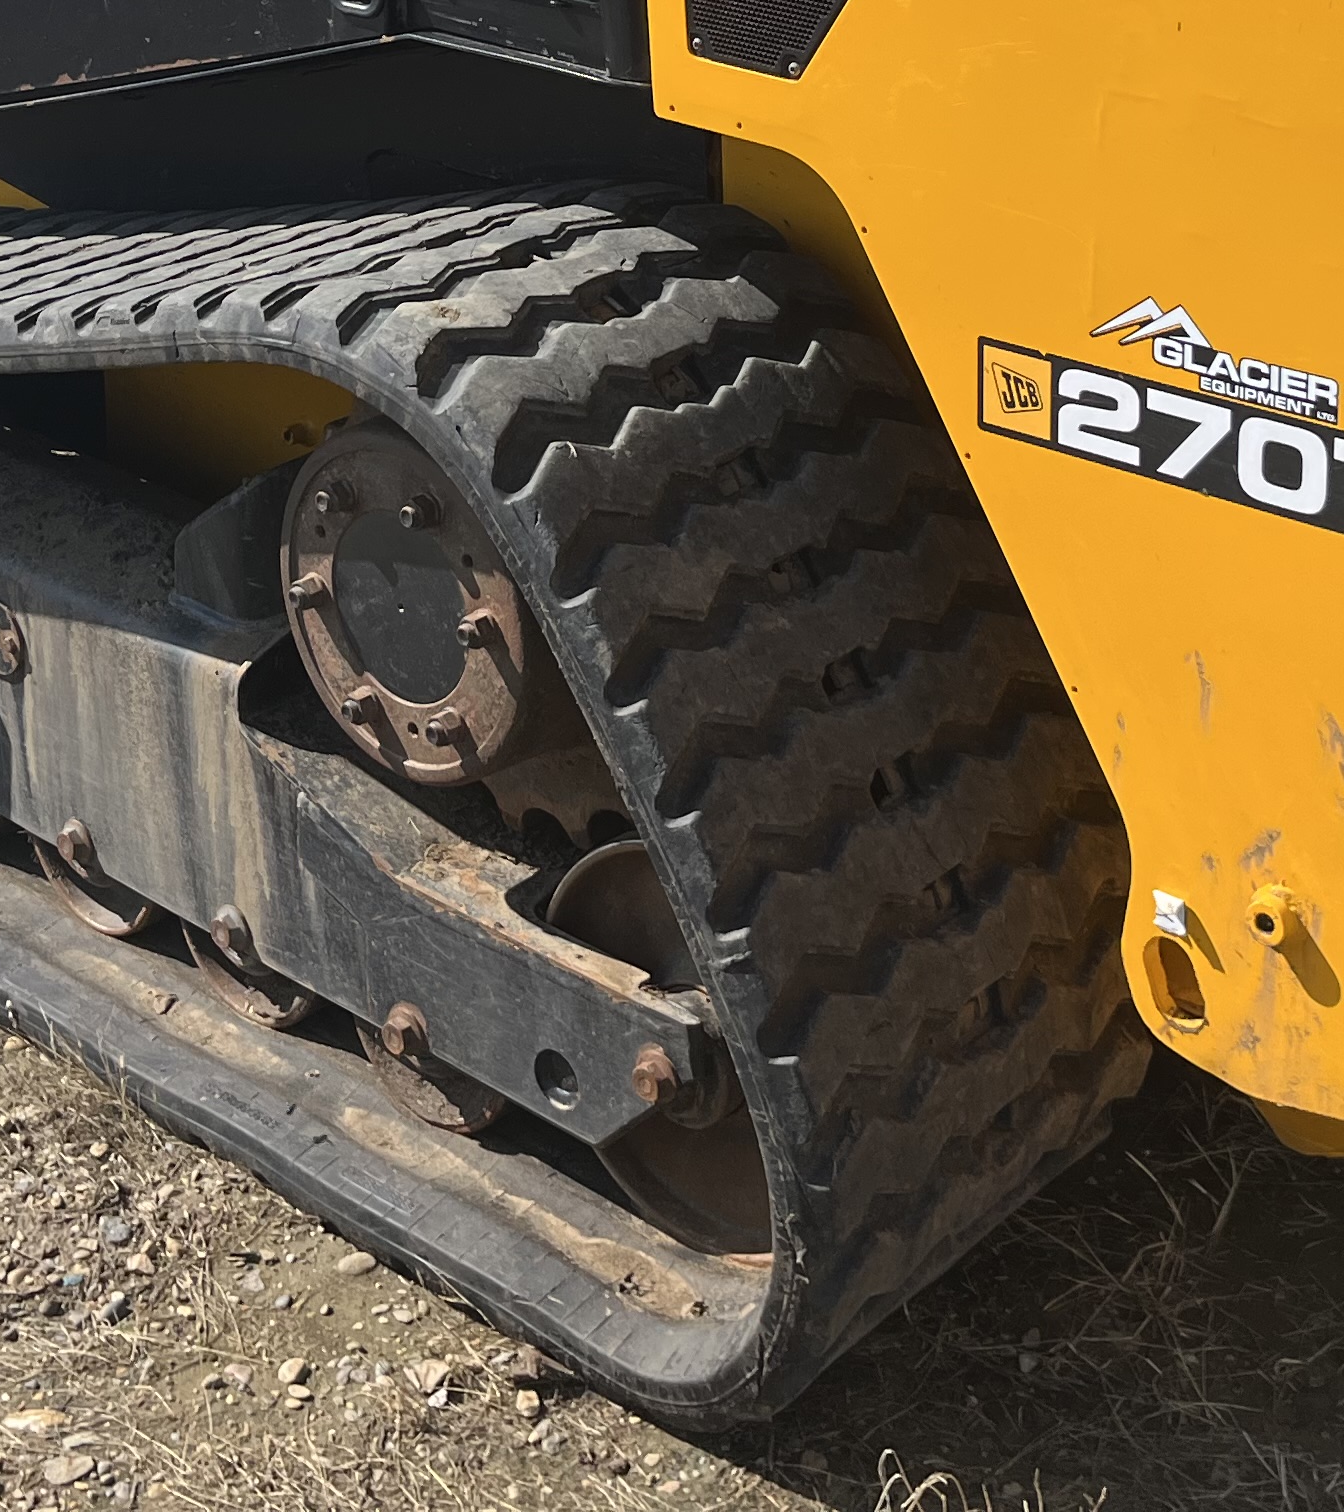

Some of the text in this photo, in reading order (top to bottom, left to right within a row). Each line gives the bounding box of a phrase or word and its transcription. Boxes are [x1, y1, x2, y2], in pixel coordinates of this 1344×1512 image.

[1001, 372, 1040, 409] JCB
[1152, 337, 1338, 407] GLACIER
[1199, 376, 1316, 417] EQUIPMENT
